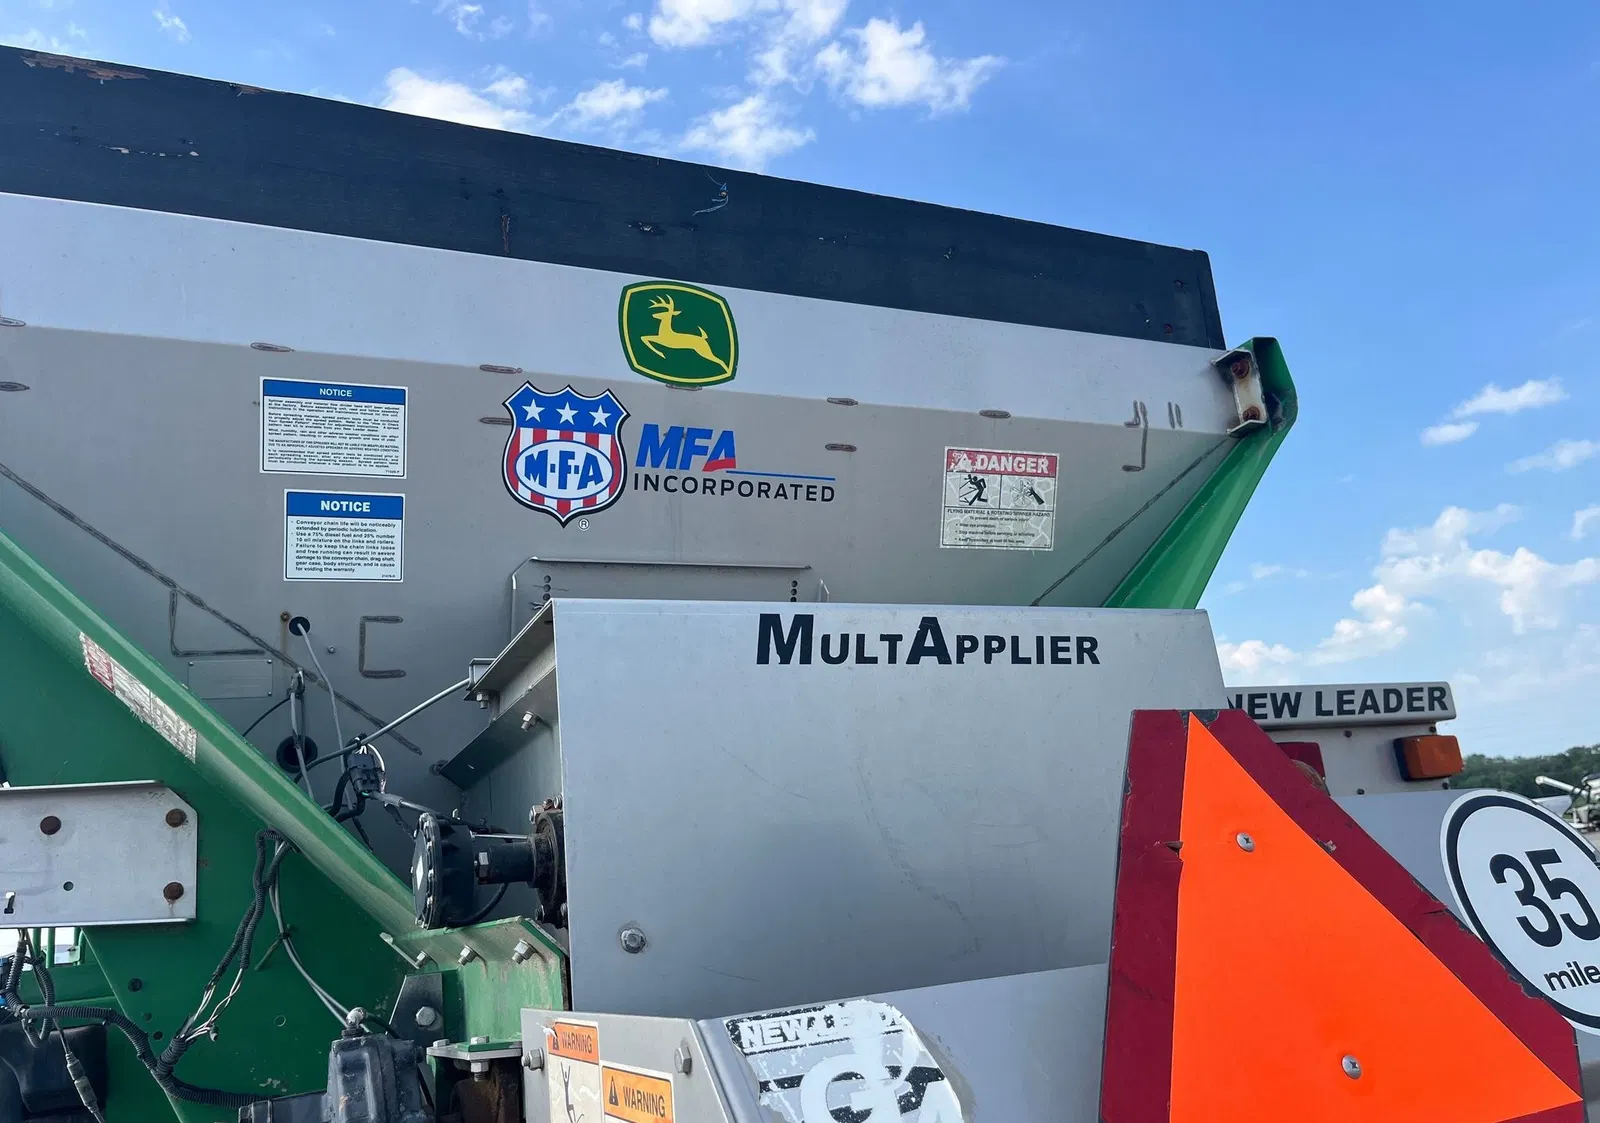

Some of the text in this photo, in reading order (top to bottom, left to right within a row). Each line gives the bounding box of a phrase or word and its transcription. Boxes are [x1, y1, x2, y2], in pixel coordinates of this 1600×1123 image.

[320, 388, 352, 397] NOTICE
[635, 423, 736, 472] MFA
[976, 455, 1049, 474] DANGER
[634, 473, 836, 502] INCORPORATED
[320, 500, 370, 512] NOTICE
[1315, 686, 1448, 716] LEADER
[1490, 848, 1600, 948] 35
[562, 1032, 592, 1054] WARNING
[623, 1086, 666, 1118] WARNING
